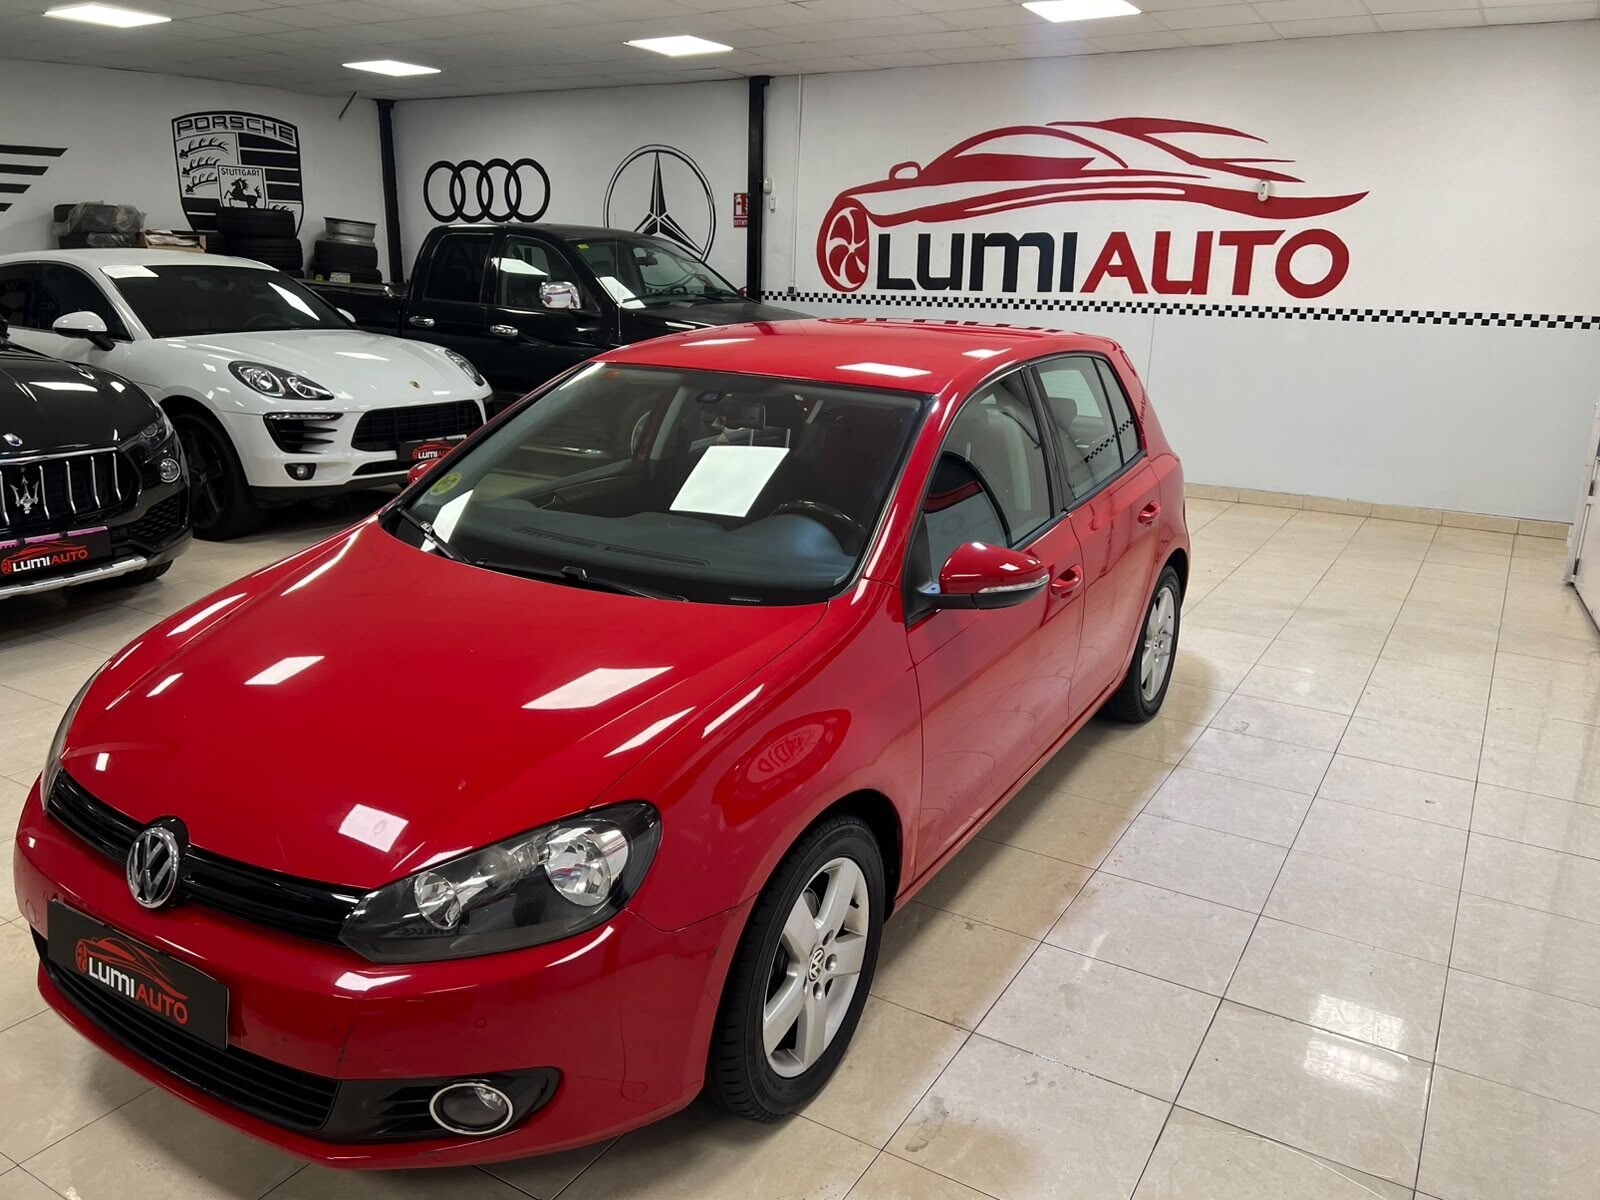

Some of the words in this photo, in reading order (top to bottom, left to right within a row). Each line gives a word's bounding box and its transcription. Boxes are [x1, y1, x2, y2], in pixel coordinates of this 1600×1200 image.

[177, 115, 294, 144] PORSCHE
[221, 167, 260, 177] STUTTGART
[88, 957, 189, 1025] LUMIAUTO
